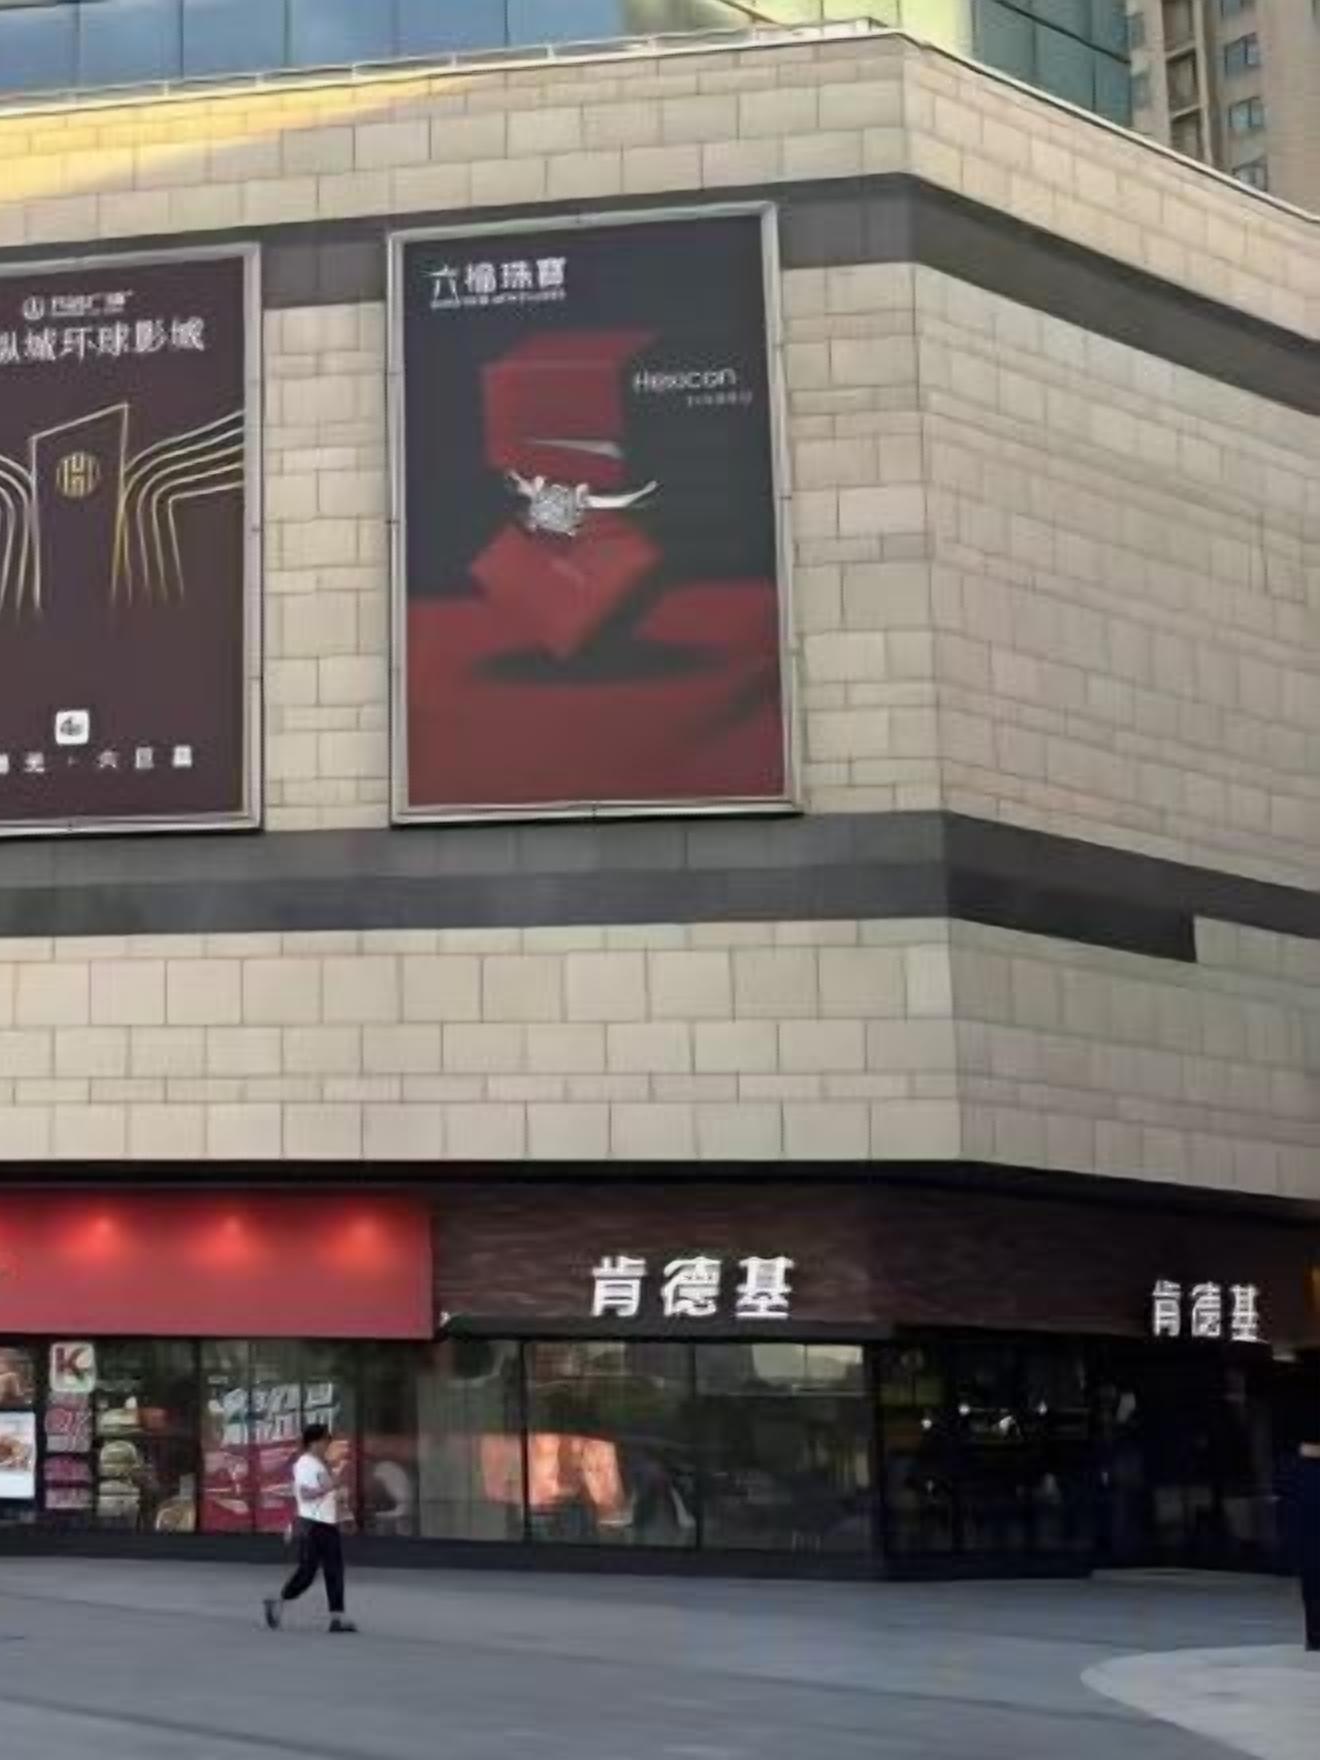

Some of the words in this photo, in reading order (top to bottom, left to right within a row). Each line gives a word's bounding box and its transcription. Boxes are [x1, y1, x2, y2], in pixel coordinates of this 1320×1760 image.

[591, 1255, 795, 1319] 肯德基
[1152, 1279, 1260, 1342] 肯德基
